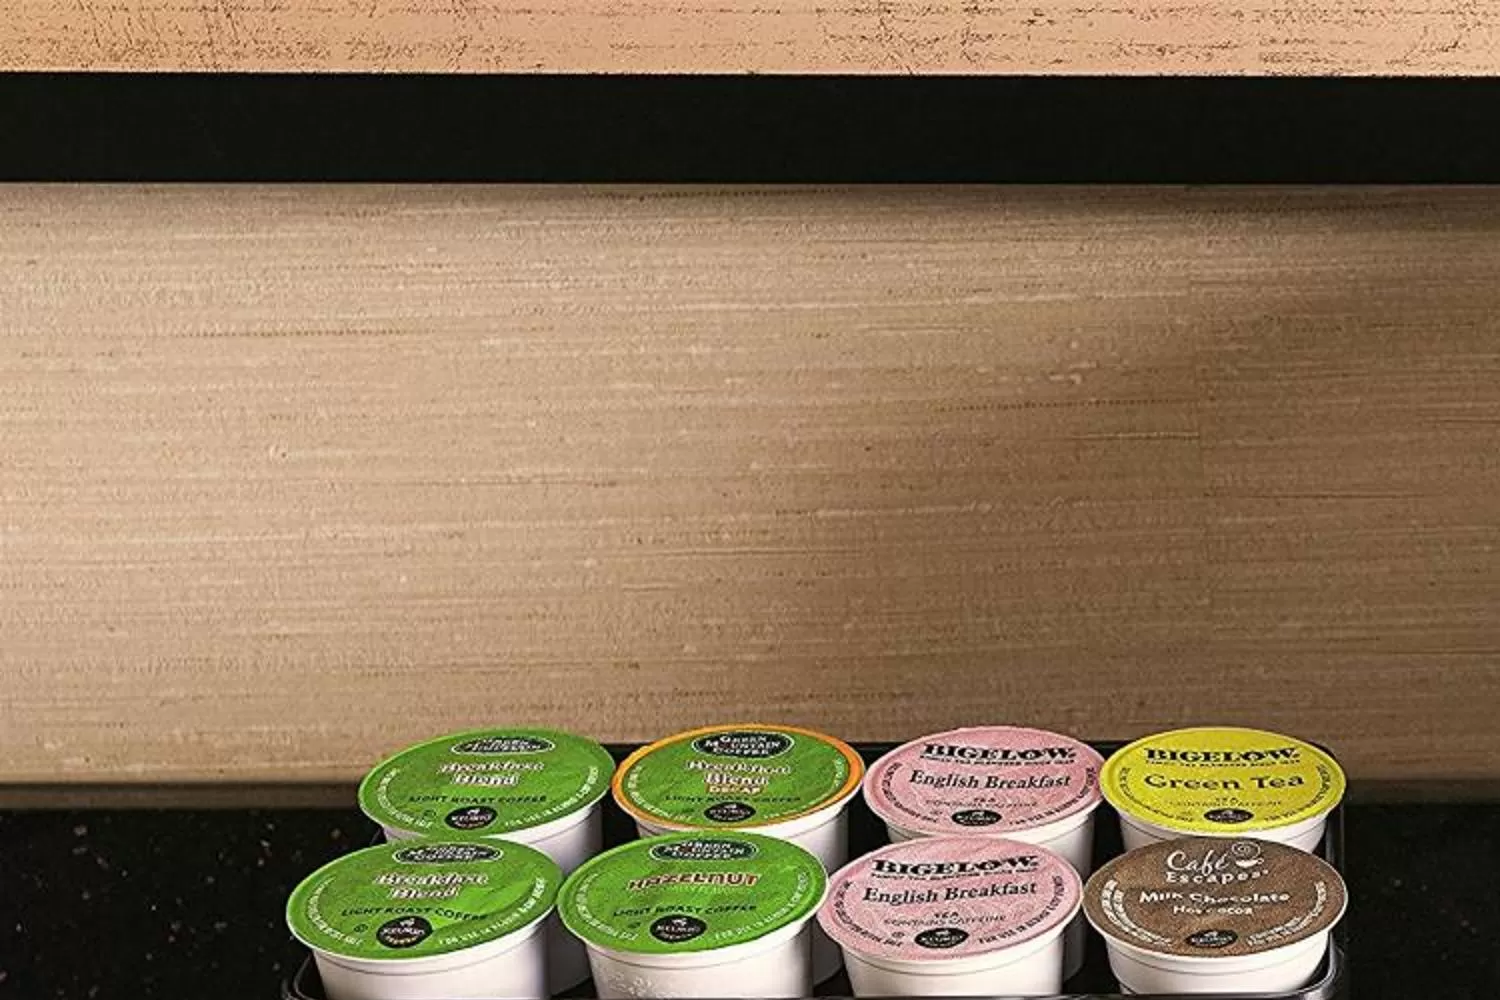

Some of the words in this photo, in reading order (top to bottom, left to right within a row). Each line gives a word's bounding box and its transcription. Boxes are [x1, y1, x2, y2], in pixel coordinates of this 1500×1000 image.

[923, 744, 1077, 760] BIGELOW
[1144, 747, 1300, 762] BIGELOW
[909, 769, 979, 790] English
[985, 774, 1071, 790] Breakfast
[1144, 773, 1242, 790] Green
[1250, 775, 1305, 789] Tea
[873, 856, 1039, 875] BIGELOW
[1166, 849, 1230, 877] Café
[862, 886, 938, 907] English
[943, 881, 1037, 902] Breakfast
[1139, 891, 1184, 903] Milk
[1190, 892, 1291, 904] Chocolate
